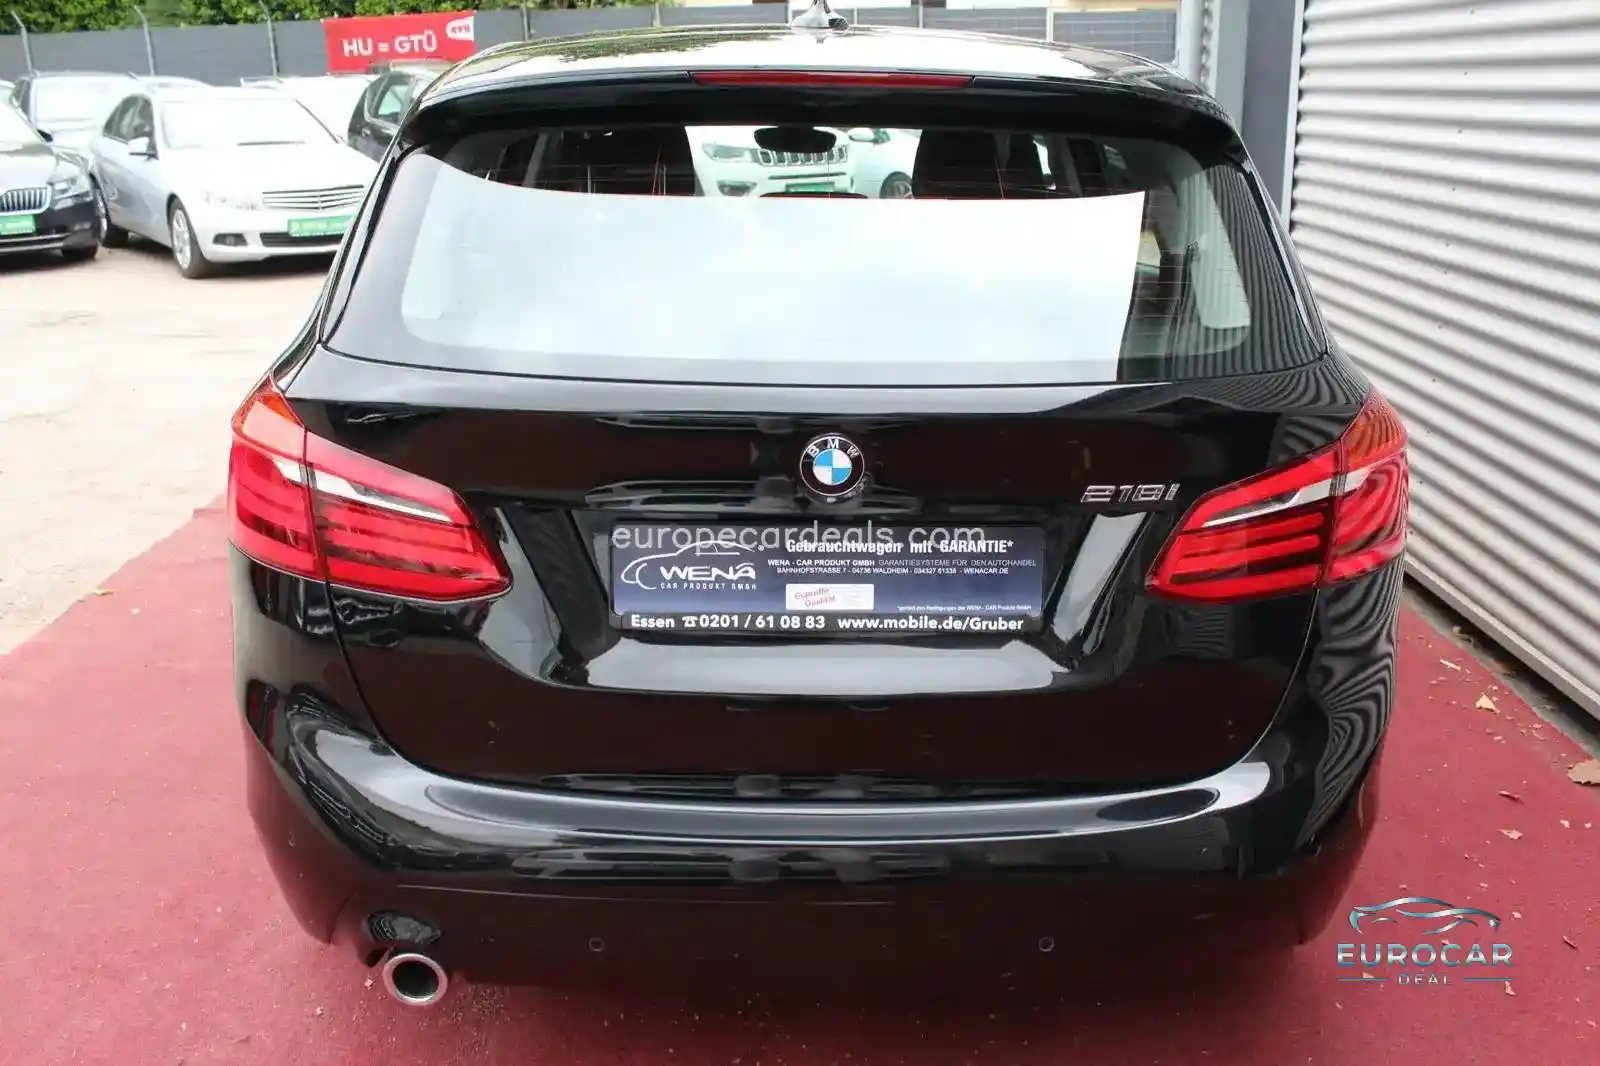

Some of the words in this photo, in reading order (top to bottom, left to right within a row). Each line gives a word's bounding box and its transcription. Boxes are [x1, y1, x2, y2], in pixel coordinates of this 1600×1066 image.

[343, 37, 373, 57] HU
[378, 42, 389, 52] =
[395, 29, 437, 53] GTÜ
[806, 438, 861, 459] BMW
[786, 539, 902, 556] Gebrauchtwagen
[910, 539, 933, 553] mit
[659, 562, 757, 581] WENA
[767, 559, 791, 567] WENA
[796, 559, 813, 567] CAR
[814, 559, 851, 567] PRODUKT
[852, 559, 875, 567] GMBH
[631, 615, 675, 628] Essen
[699, 615, 739, 628] 0201
[755, 615, 774, 628] 61
[780, 615, 801, 629] 08
[804, 615, 826, 629] 83
[837, 615, 1024, 631] www.mobile.de/Gruber
